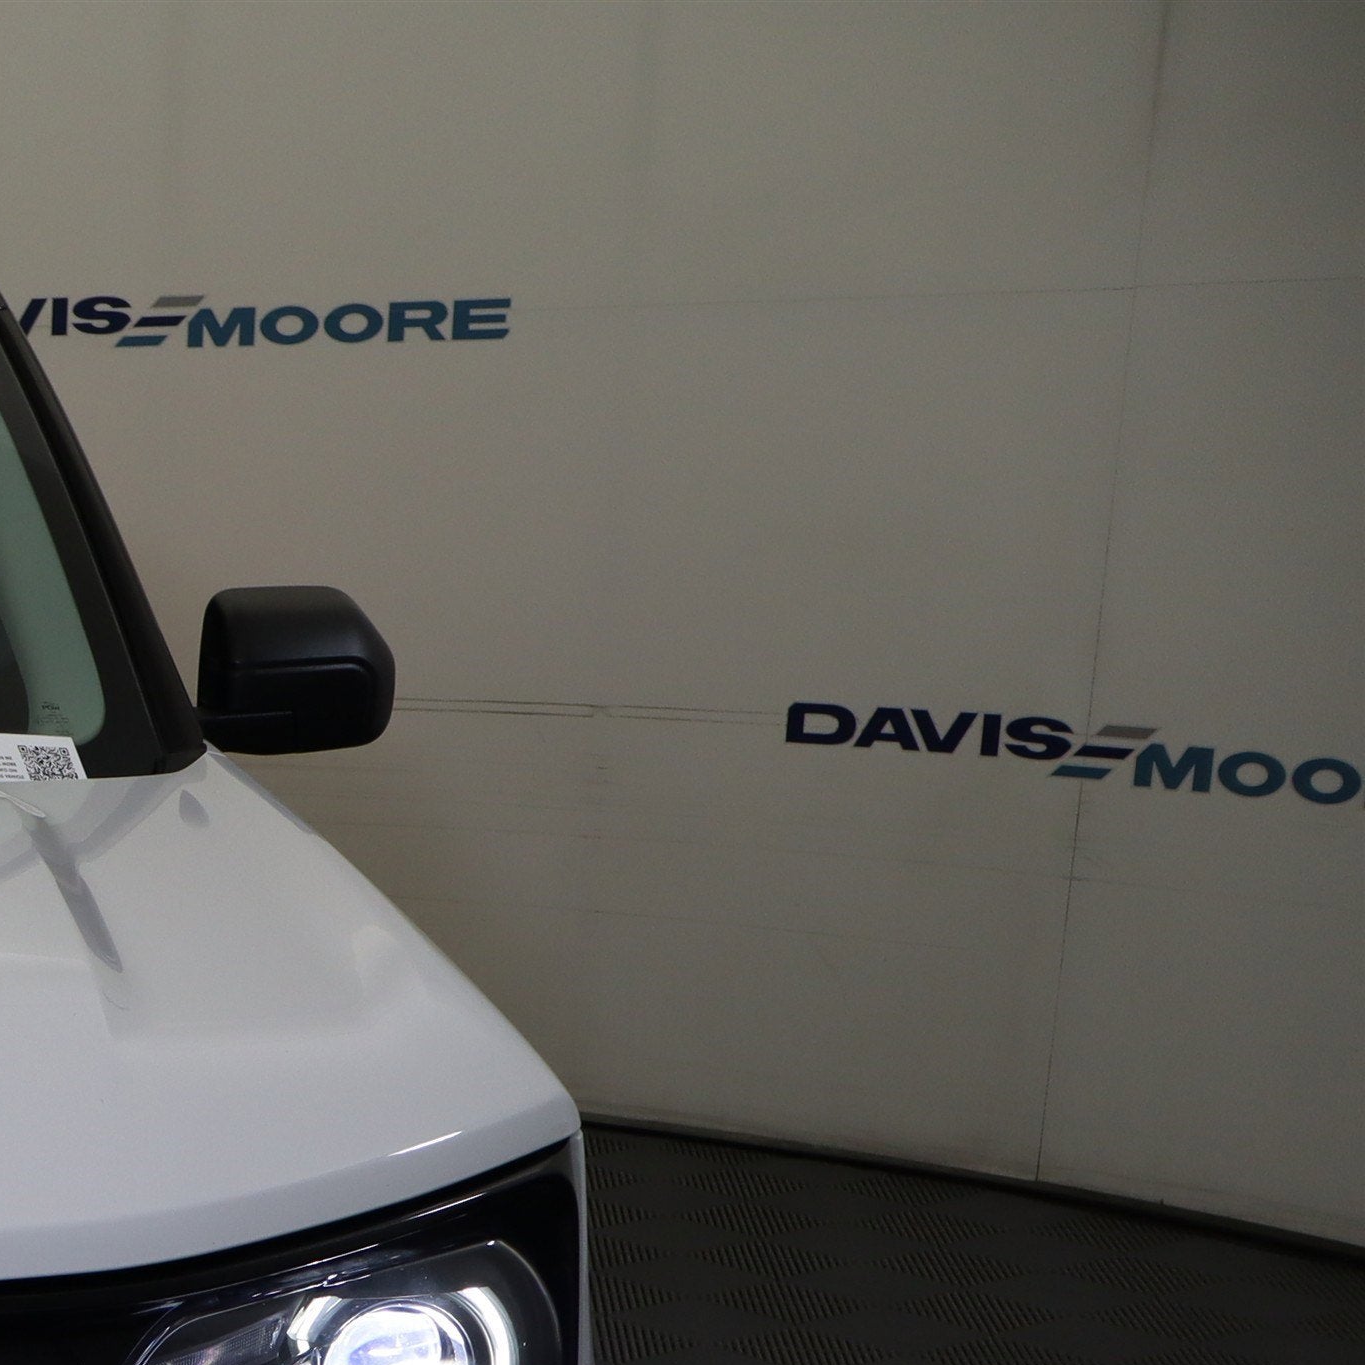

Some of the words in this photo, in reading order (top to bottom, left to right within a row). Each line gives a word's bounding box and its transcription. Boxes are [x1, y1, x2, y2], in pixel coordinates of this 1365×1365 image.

[19, 296, 132, 337] VIS
[187, 298, 512, 347] MOORE
[785, 702, 1075, 761] DAVIS
[1133, 743, 1365, 805] MOO
